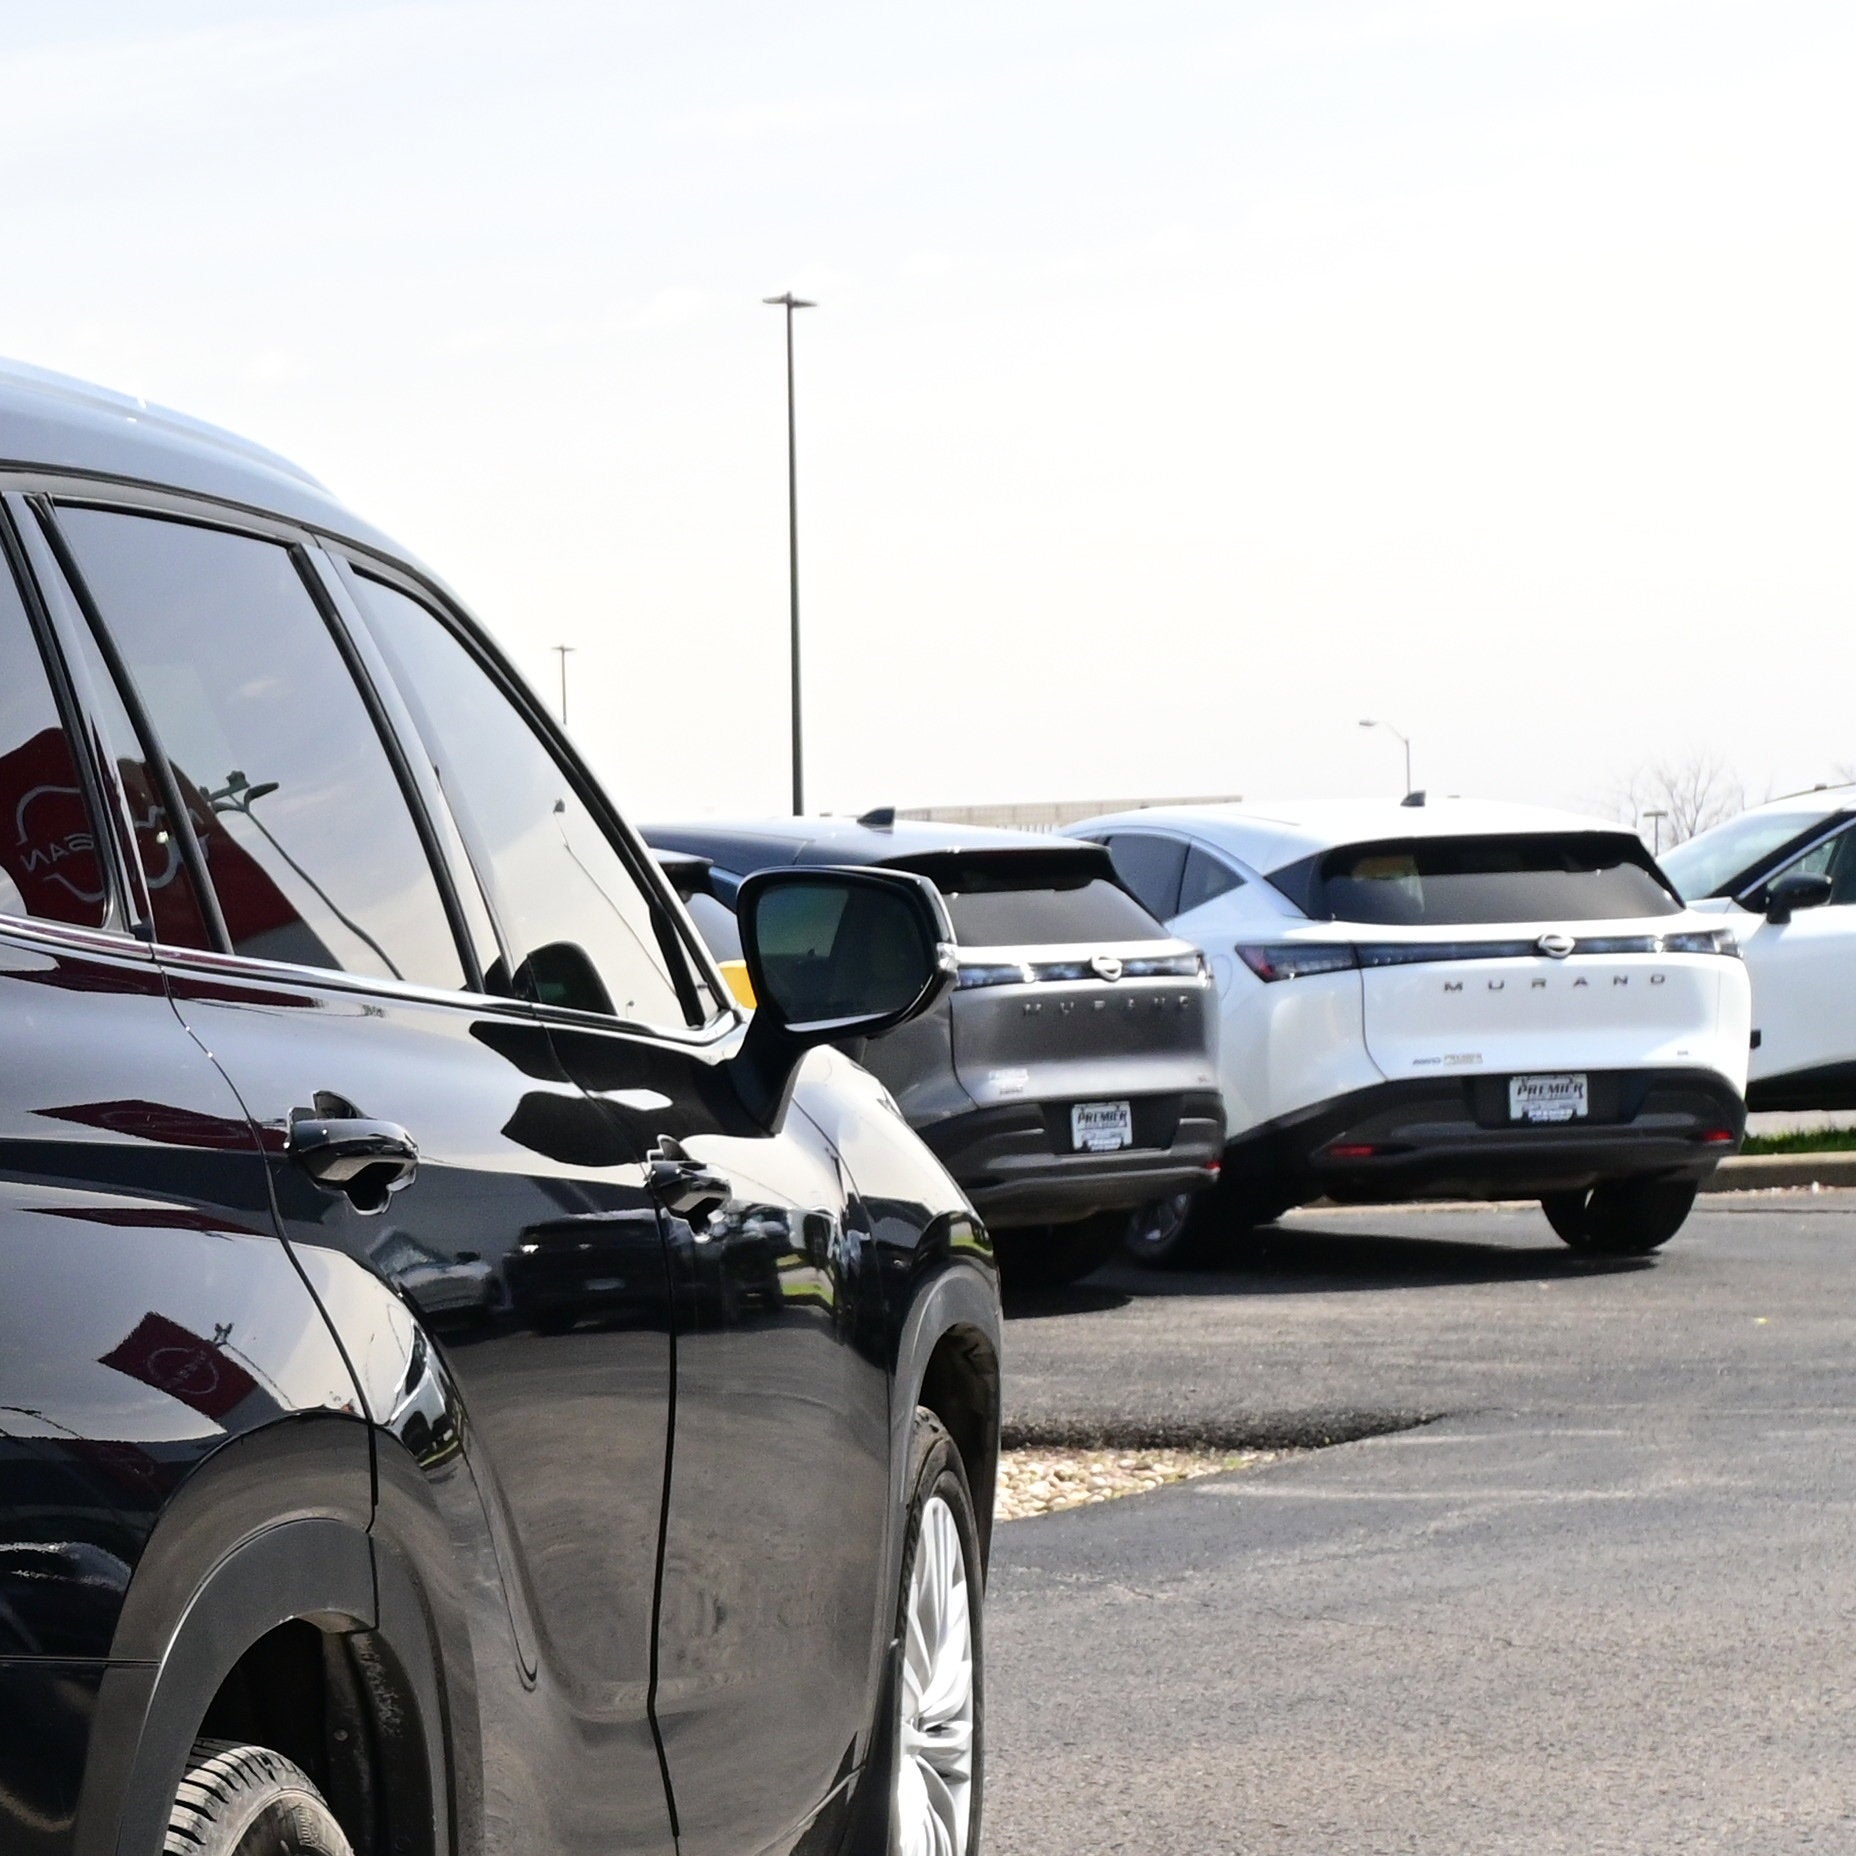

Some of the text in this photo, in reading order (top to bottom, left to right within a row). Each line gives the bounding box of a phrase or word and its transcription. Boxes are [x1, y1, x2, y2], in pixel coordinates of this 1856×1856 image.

[1443, 974, 1666, 993] MURANO
[1516, 1083, 1584, 1099] PREMIER
[1077, 1111, 1128, 1125] PREMIER
